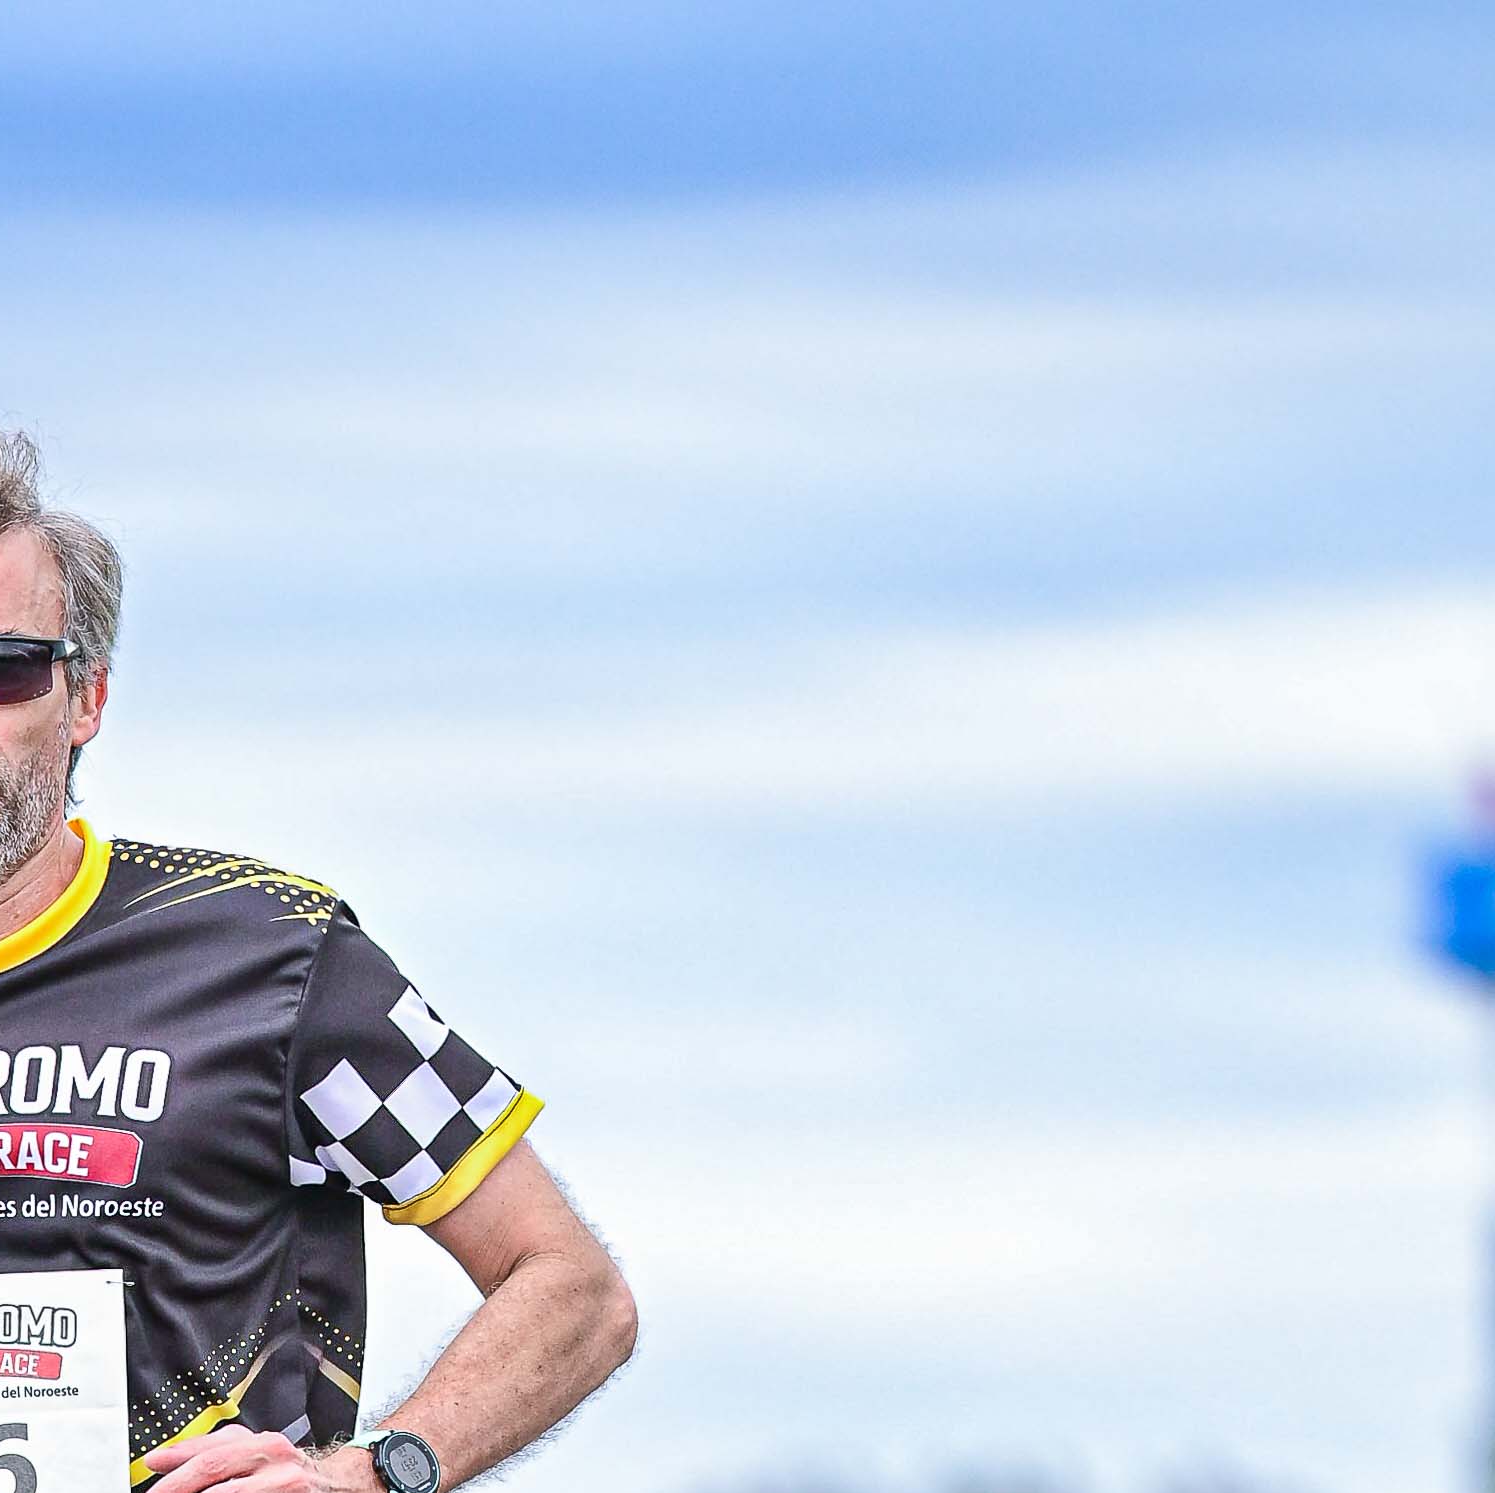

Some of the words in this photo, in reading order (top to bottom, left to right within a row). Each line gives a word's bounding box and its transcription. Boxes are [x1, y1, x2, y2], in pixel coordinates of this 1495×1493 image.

[22, 1194, 55, 1218] del
[61, 1194, 164, 1218] Noroeste
[1, 1385, 21, 1399] del
[24, 1385, 79, 1398] Noroeste
